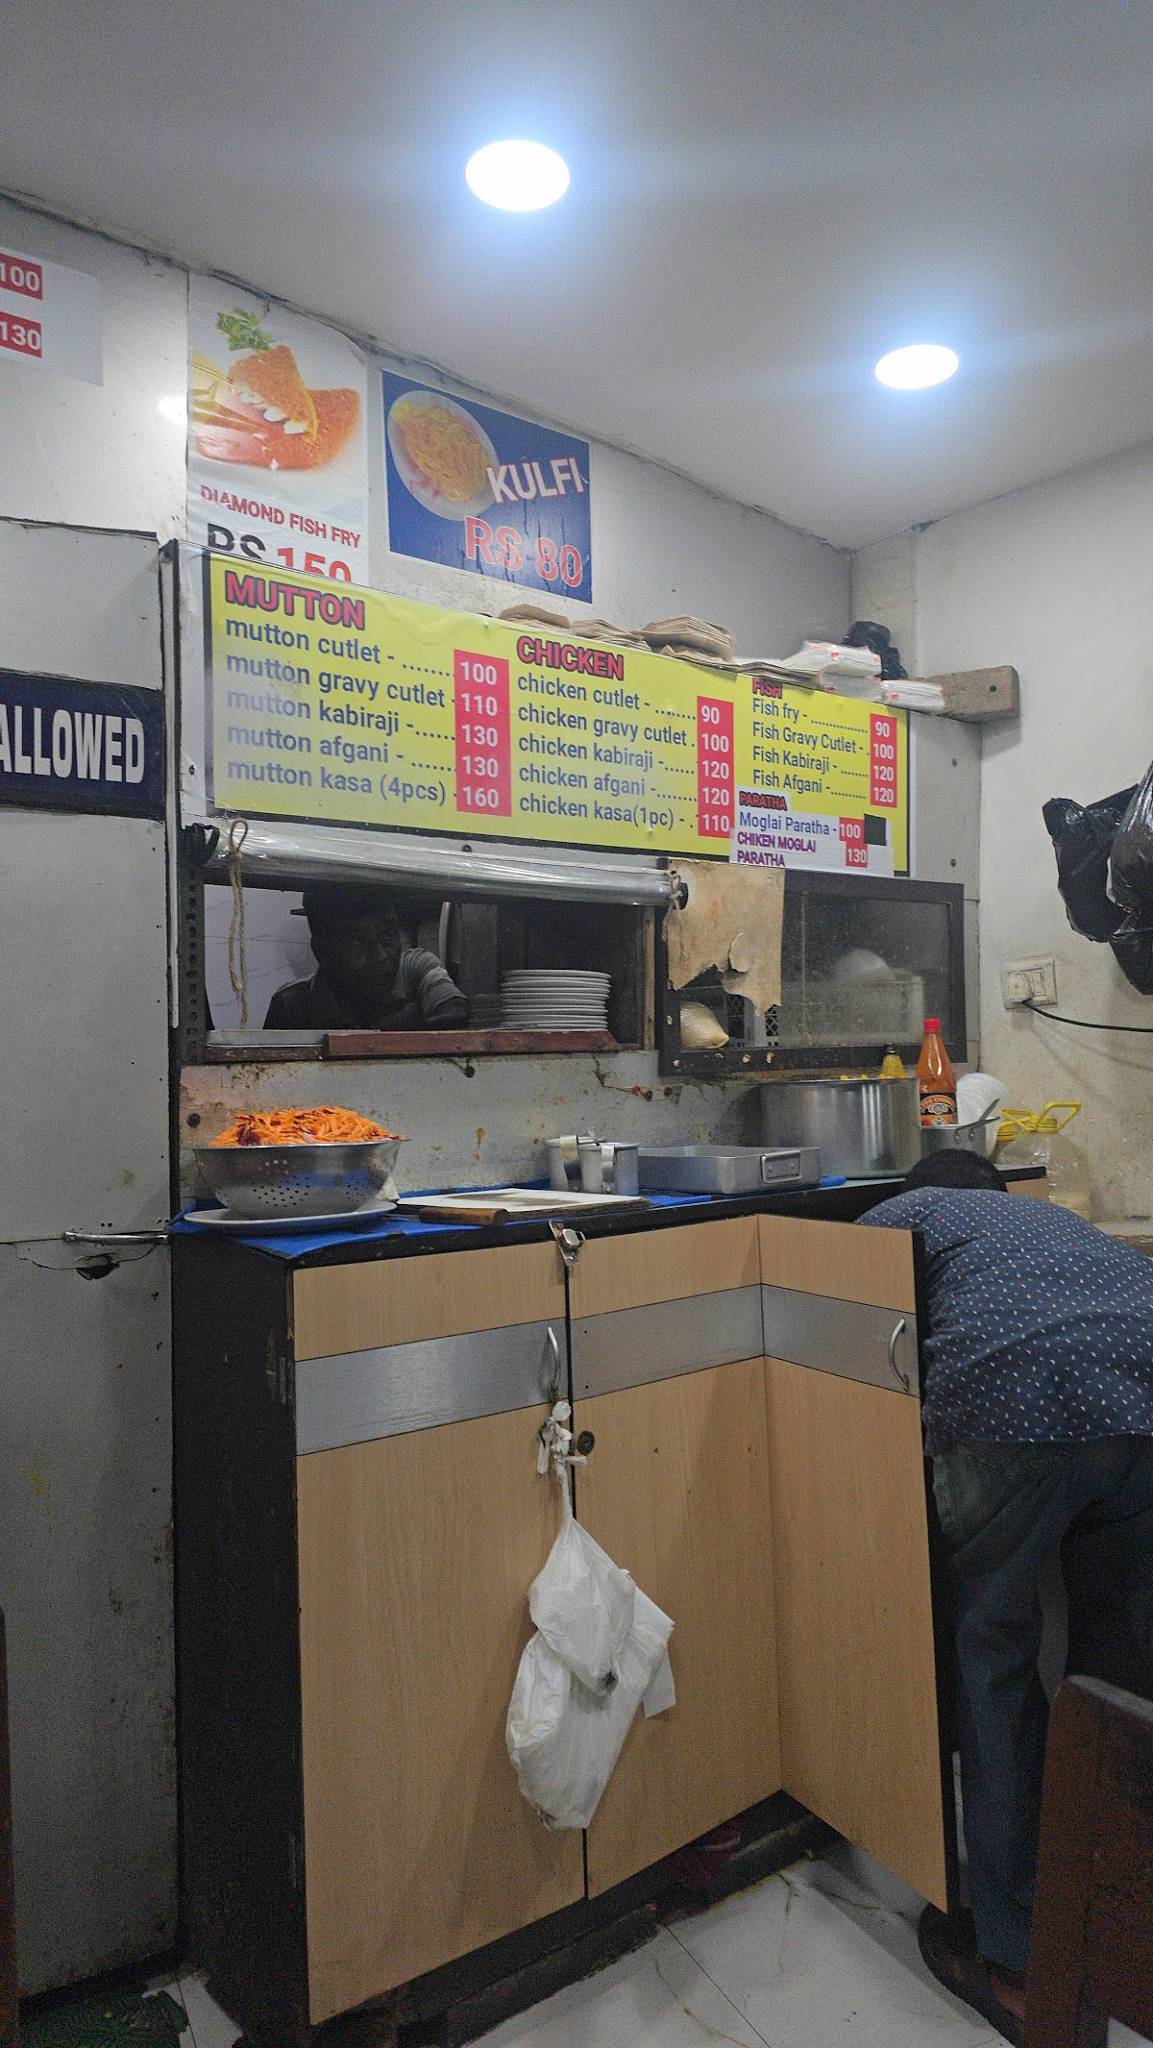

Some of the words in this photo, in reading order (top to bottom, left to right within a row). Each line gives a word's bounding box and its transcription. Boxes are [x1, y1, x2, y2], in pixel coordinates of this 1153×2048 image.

[0, 262, 40, 292] 100
[0, 321, 41, 351] 130
[485, 457, 584, 503] KULFI
[200, 485, 285, 525] DIAMOND
[289, 512, 327, 539] FISH
[331, 526, 361, 548] FRY
[464, 515, 524, 571] RS
[535, 537, 583, 587] 80
[224, 570, 366, 631] MUTTON
[226, 618, 310, 651] mutton
[318, 638, 381, 664] cutlet
[460, 661, 498, 685] 100
[517, 635, 625, 681] CHICKEN
[226, 654, 310, 685] mutton
[319, 671, 379, 701] gravy
[387, 683, 445, 708] cutlet
[461, 693, 498, 716] 110
[517, 673, 587, 701] chicken
[593, 688, 640, 711] cutlet
[701, 705, 720, 724] 90
[227, 690, 311, 719] mutton
[319, 699, 399, 736] kabiraji
[462, 724, 499, 747] 130
[518, 703, 587, 731] chicken
[593, 718, 638, 742] gravy
[644, 726, 687, 746] cutlet
[702, 733, 729, 752] 100
[752, 698, 780, 717] Fish
[783, 703, 799, 724] fry
[875, 721, 891, 737] 90
[752, 721, 780, 740] Fish
[783, 727, 818, 751] Gravy
[821, 733, 857, 754] Cutlet
[873, 743, 894, 760] 100
[227, 725, 312, 753] mutton
[320, 735, 389, 763] afgani
[462, 755, 499, 778] 130
[518, 733, 588, 760] chicken
[593, 743, 654, 772] kabiraji
[702, 760, 729, 780] 120
[752, 746, 780, 764] Fish
[783, 750, 830, 774] Kabiraji
[873, 765, 895, 781] 120
[228, 761, 313, 787] mutton
[321, 767, 373, 793] kasa
[380, 774, 446, 807] (4pcs)
[463, 786, 499, 808] 160
[519, 763, 588, 789] chicken
[593, 773, 645, 796] afgani
[702, 787, 729, 806] 120
[739, 791, 788, 811] PARATHA
[753, 769, 780, 787] Fish
[783, 773, 823, 794] Afgani
[873, 787, 894, 803] 120
[519, 793, 588, 818] chicken
[703, 814, 730, 832] 110
[739, 812, 782, 832] Moglai
[785, 817, 830, 835] Paratha
[840, 823, 861, 839] 100
[737, 850, 785, 867] PARATHA
[848, 848, 867, 863] 130
